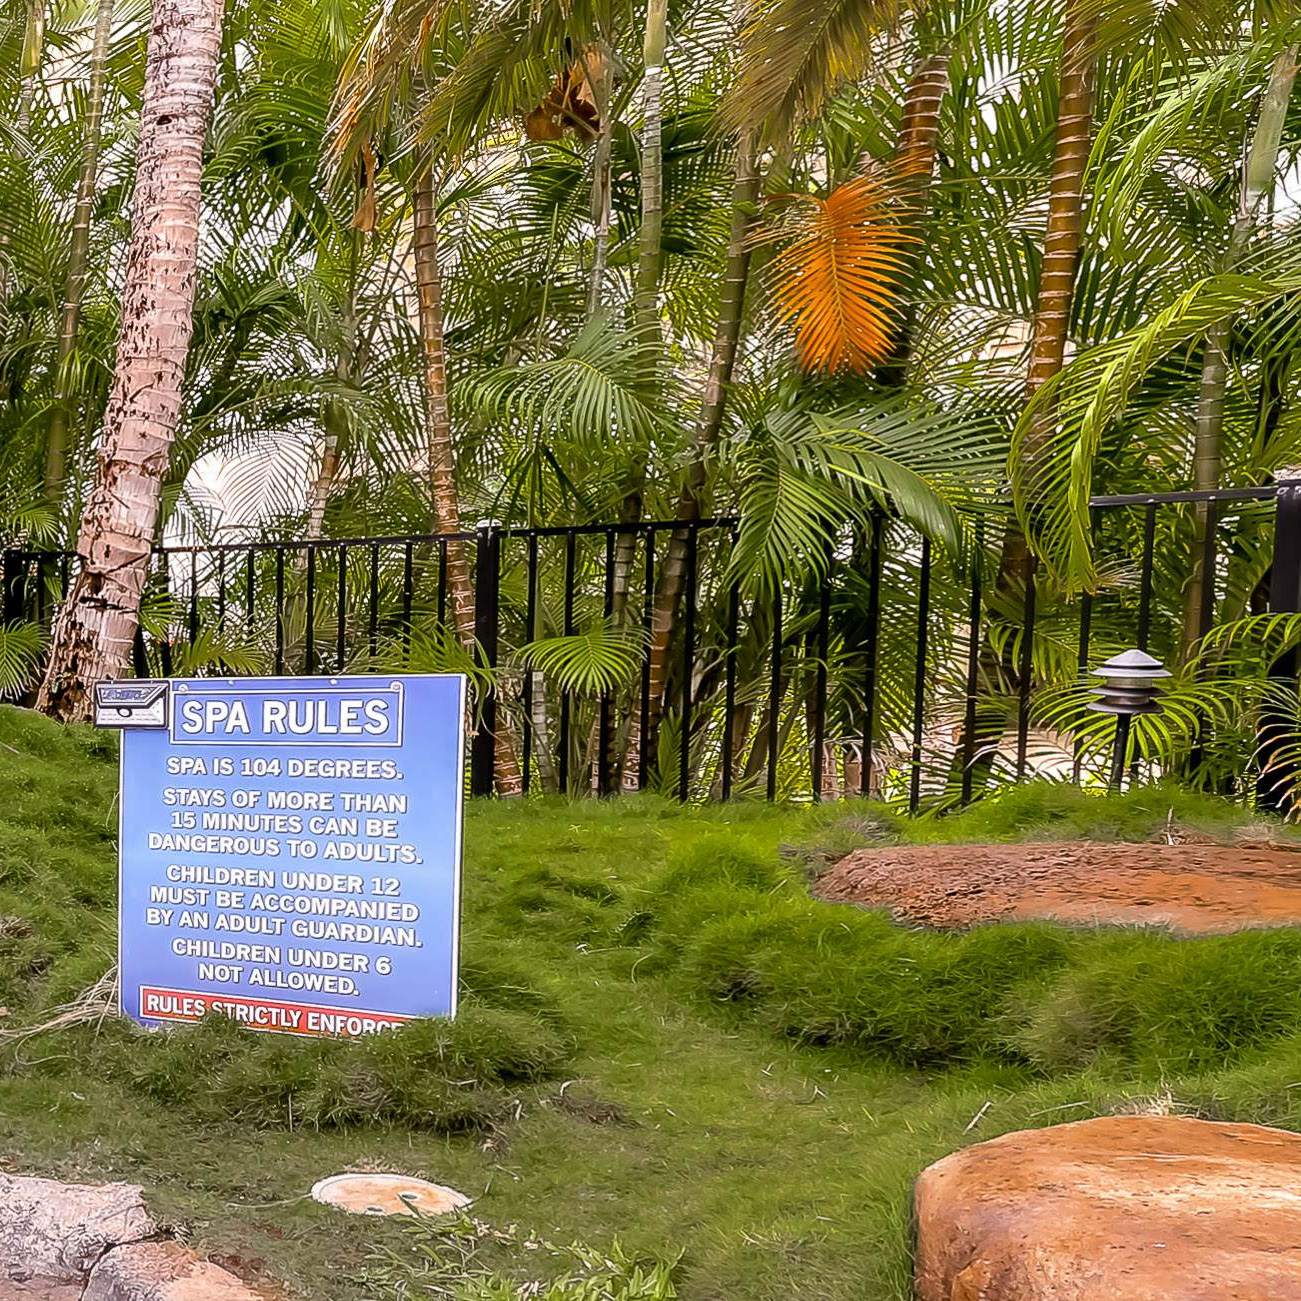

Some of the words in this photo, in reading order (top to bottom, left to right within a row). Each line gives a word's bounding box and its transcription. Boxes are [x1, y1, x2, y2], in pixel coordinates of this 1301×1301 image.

[181, 700, 250, 734] SPA
[263, 699, 389, 735] RULES
[166, 757, 207, 775] SPA
[213, 759, 233, 776] IS
[241, 759, 281, 777] 104
[288, 760, 403, 779] DEGREES.
[163, 788, 226, 807] STAYS
[232, 791, 261, 808] OF
[267, 792, 334, 811] MORE
[341, 793, 407, 813] THAN
[172, 813, 196, 829] 15
[202, 813, 302, 834] MINUTES
[309, 817, 357, 836] CAN
[365, 819, 398, 837] BE
[148, 833, 279, 856] DANGEROUS
[286, 839, 317, 858] TO
[323, 841, 423, 863] ADULTS.
[166, 865, 275, 888] CHILDREN
[282, 872, 364, 893] UNDER
[371, 877, 400, 895] 12
[150, 887, 210, 906] MUST
[216, 891, 244, 909] BE
[250, 893, 419, 922] ACCOMPANIED
[146, 909, 173, 926] BY
[179, 910, 209, 929] AN
[215, 913, 286, 935] ADULT
[291, 920, 423, 947] GUARDIAN.
[172, 938, 281, 963] CHILDREN
[288, 948, 368, 972] UNDER
[375, 957, 391, 975] 6
[199, 964, 243, 983] NOT
[249, 967, 359, 996] ALLOWED.
[147, 995, 206, 1016] RULES
[211, 1001, 302, 1028] STRICTLY
